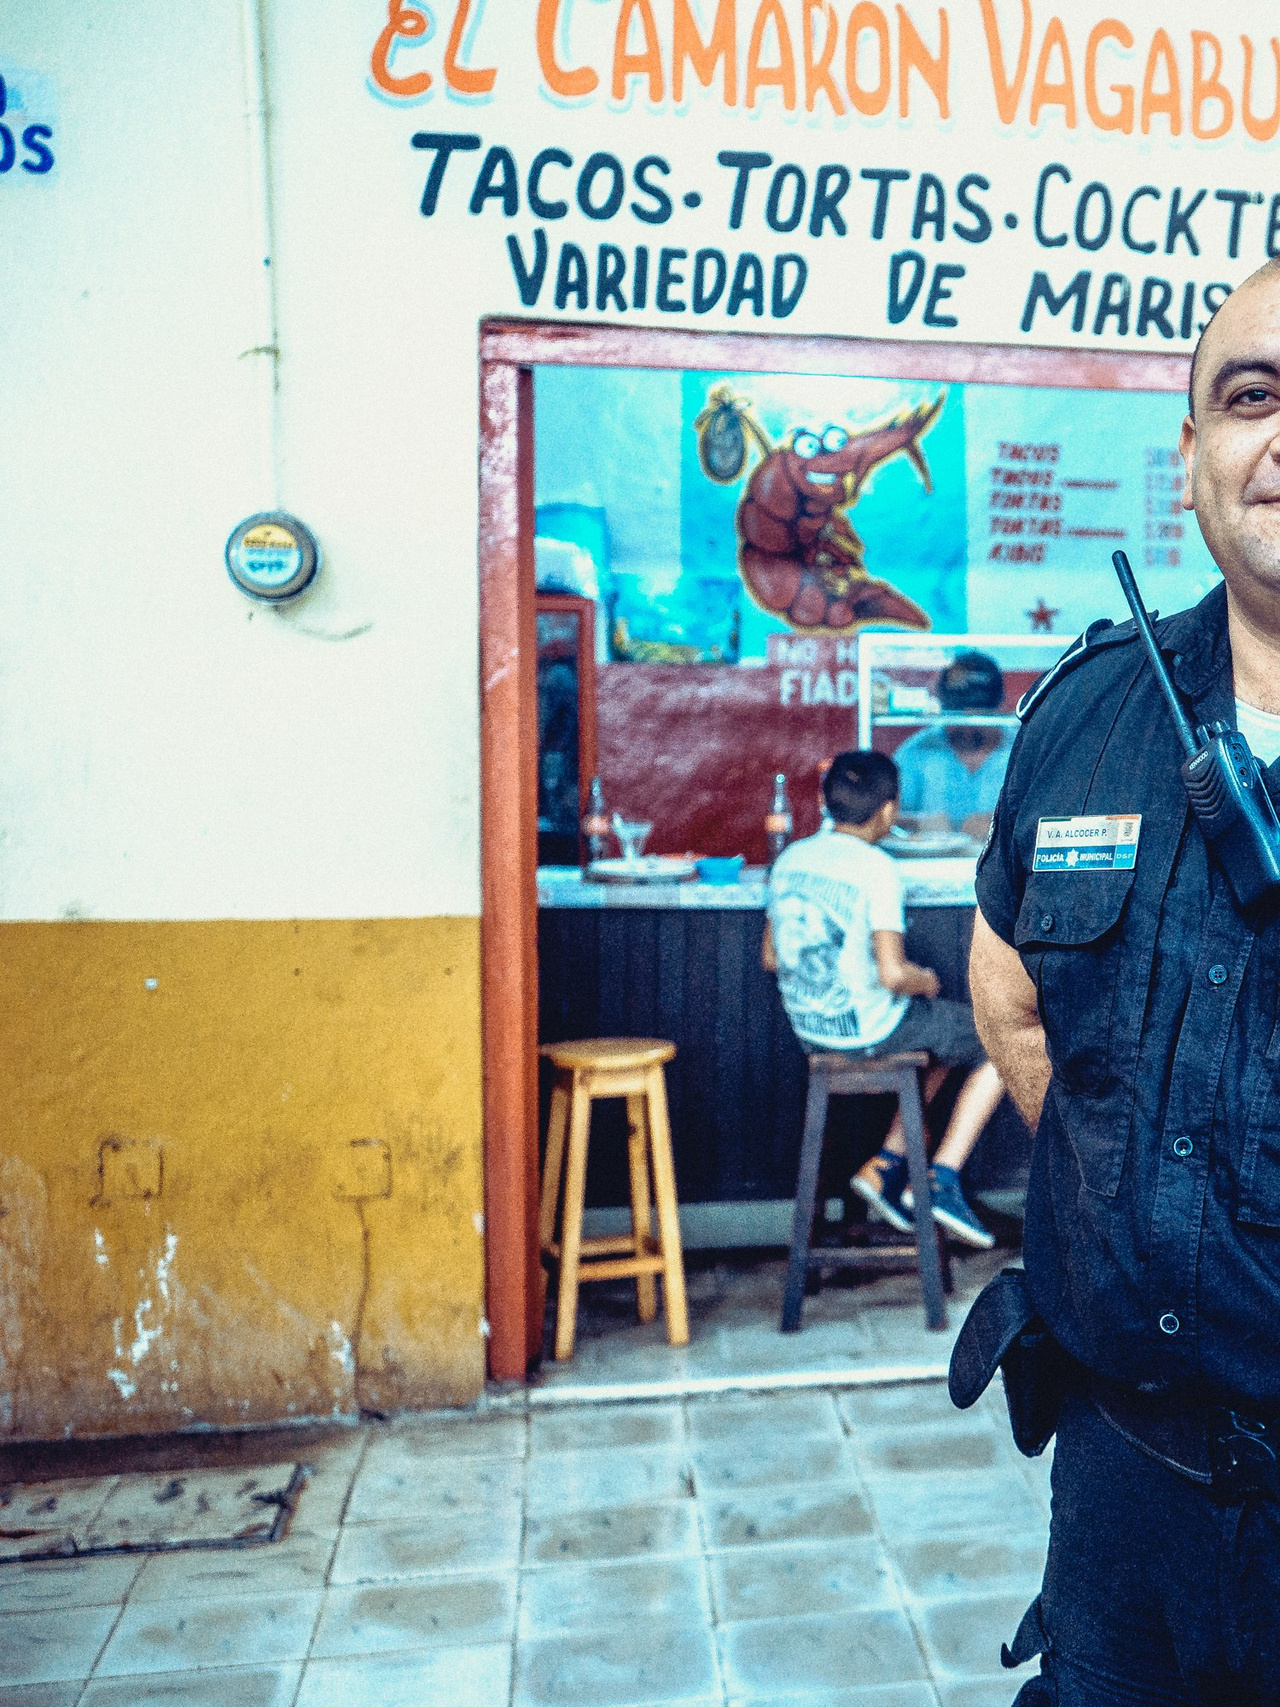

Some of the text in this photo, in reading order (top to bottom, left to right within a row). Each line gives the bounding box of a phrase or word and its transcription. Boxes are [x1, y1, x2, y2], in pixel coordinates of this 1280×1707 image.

[536, 0, 950, 119] CAMARON
[505, 227, 808, 320] VARIEDAD
[886, 250, 967, 328] DE
[1189, 751, 1209, 770] KENWOOD
[1065, 828, 1100, 838] ALCOCER
[1080, 852, 1113, 862] MUNICIPAL
